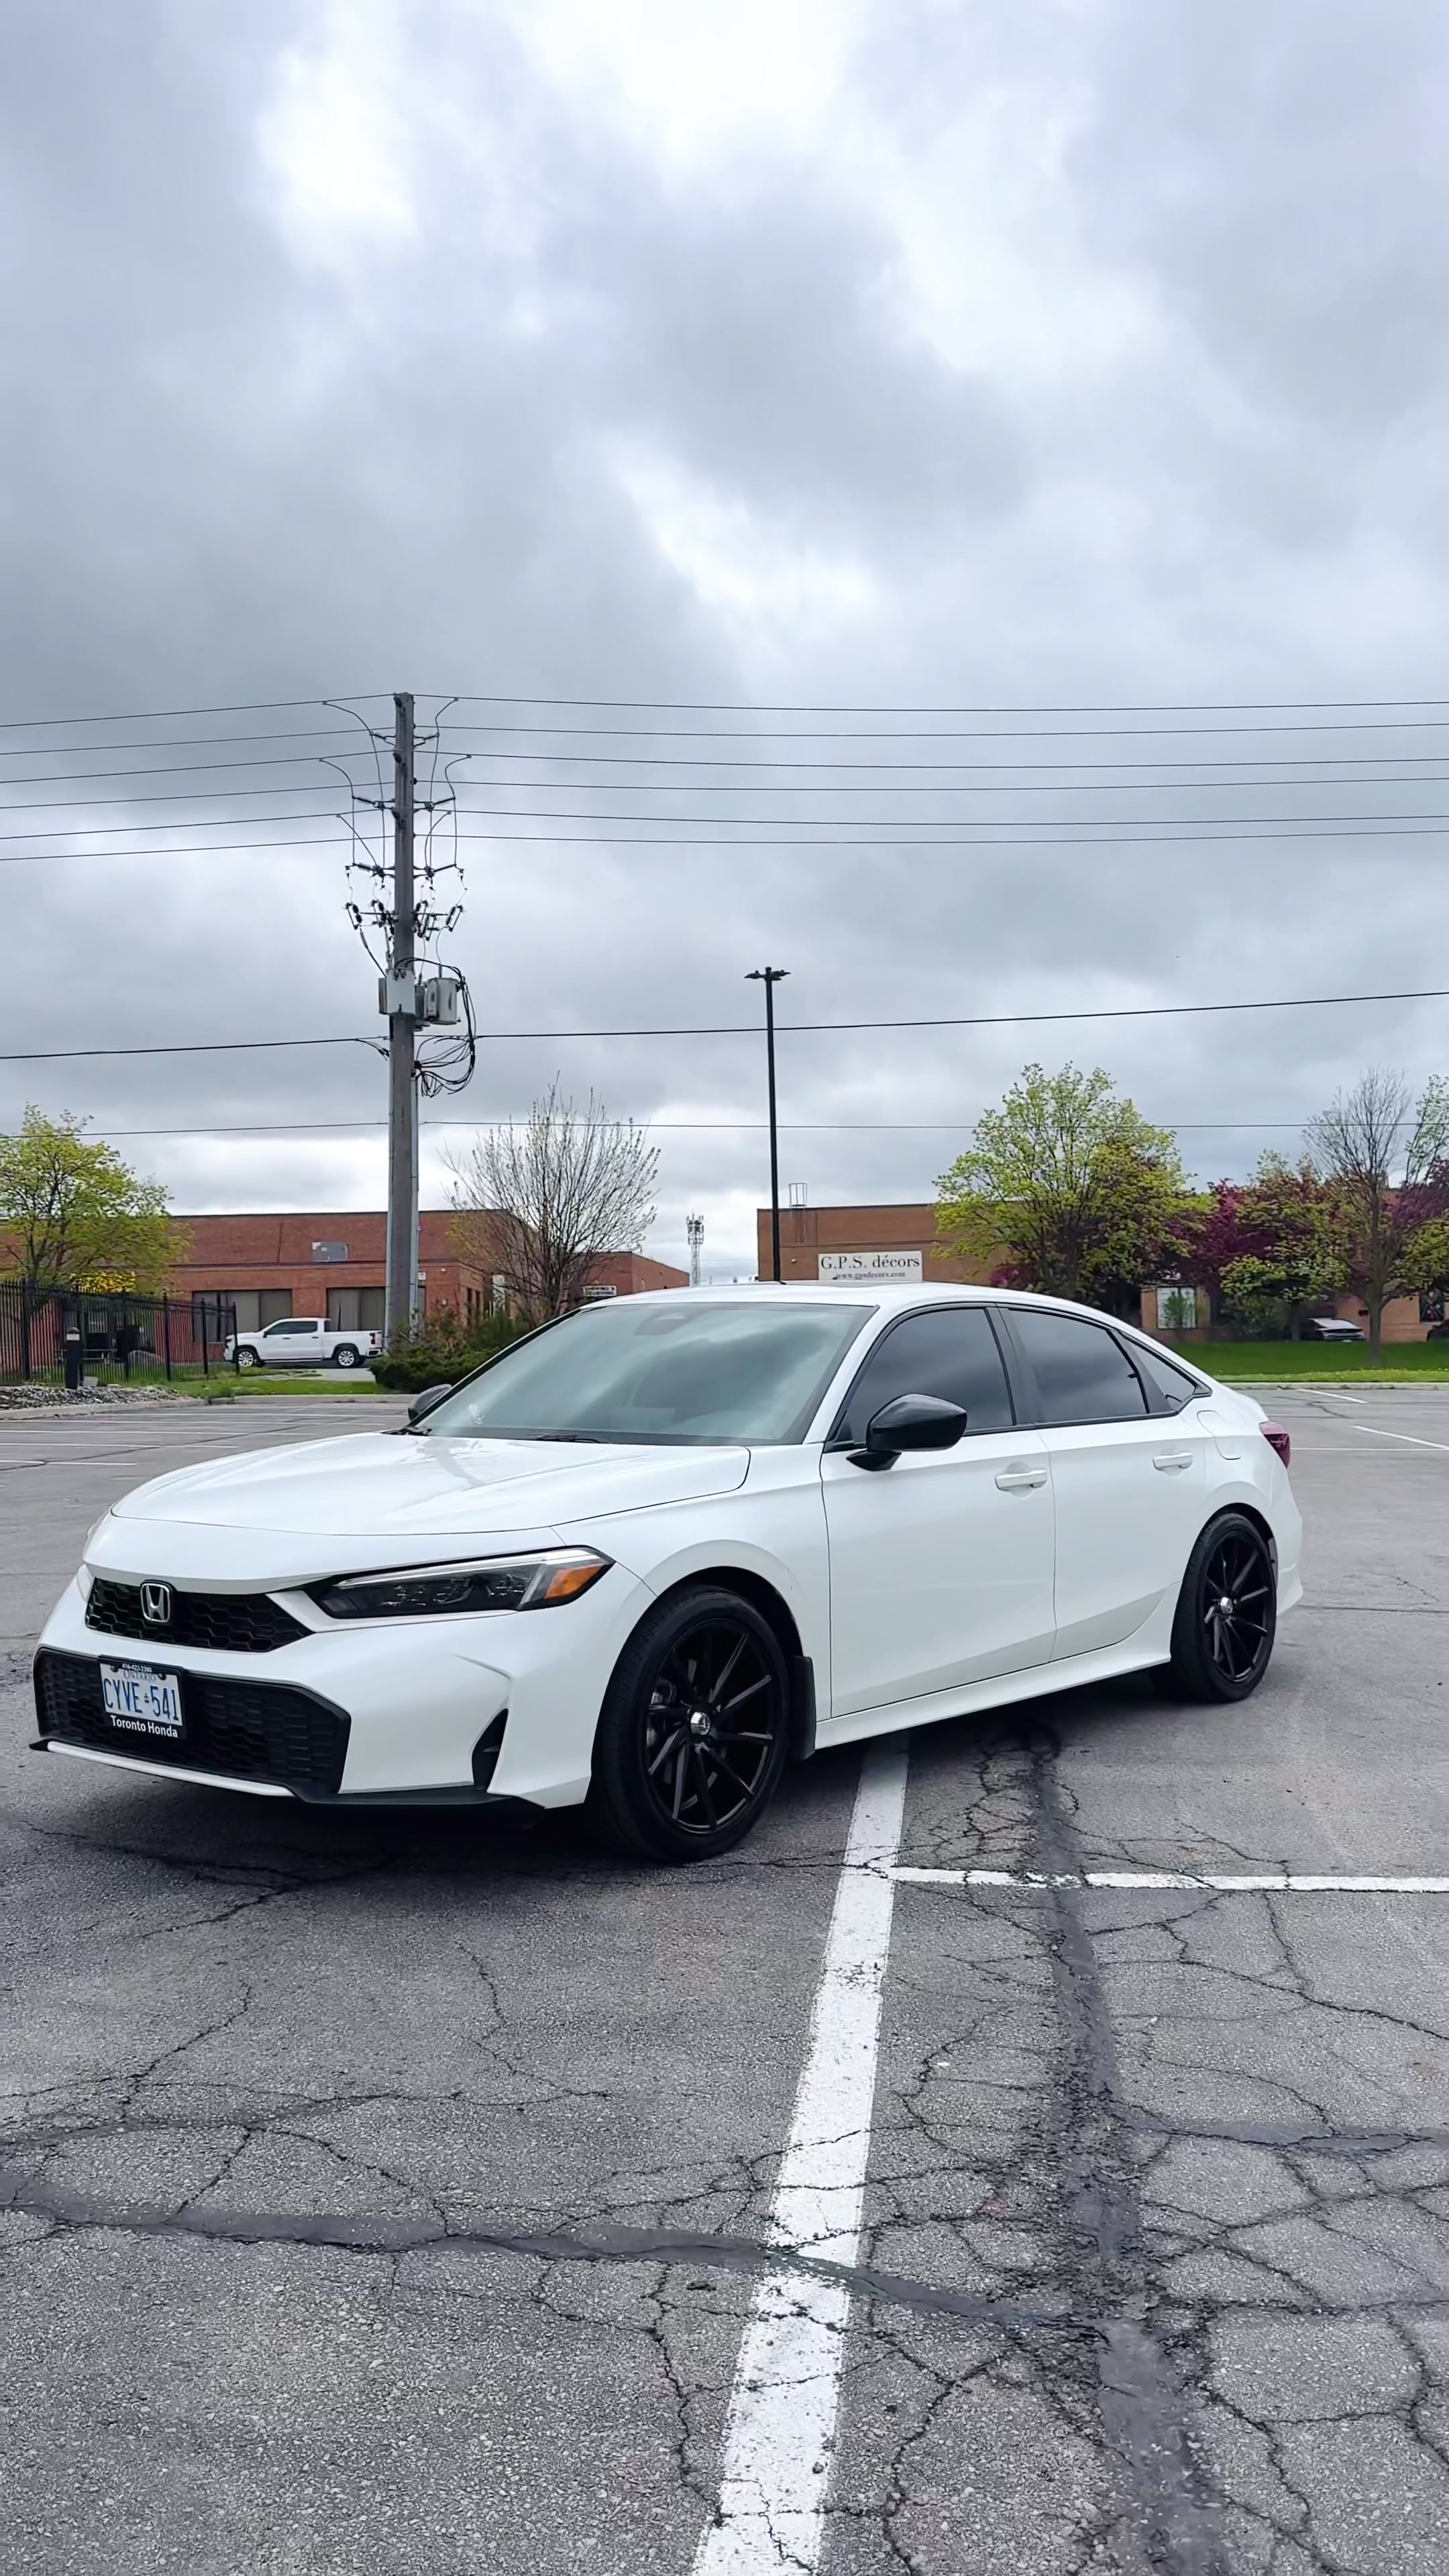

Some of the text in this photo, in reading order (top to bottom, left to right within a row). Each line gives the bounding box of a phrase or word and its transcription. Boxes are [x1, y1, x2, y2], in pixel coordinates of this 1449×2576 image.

[820, 1254, 920, 1269] G.P.S. décors
[110, 1715, 178, 1738] Toronto Honda
